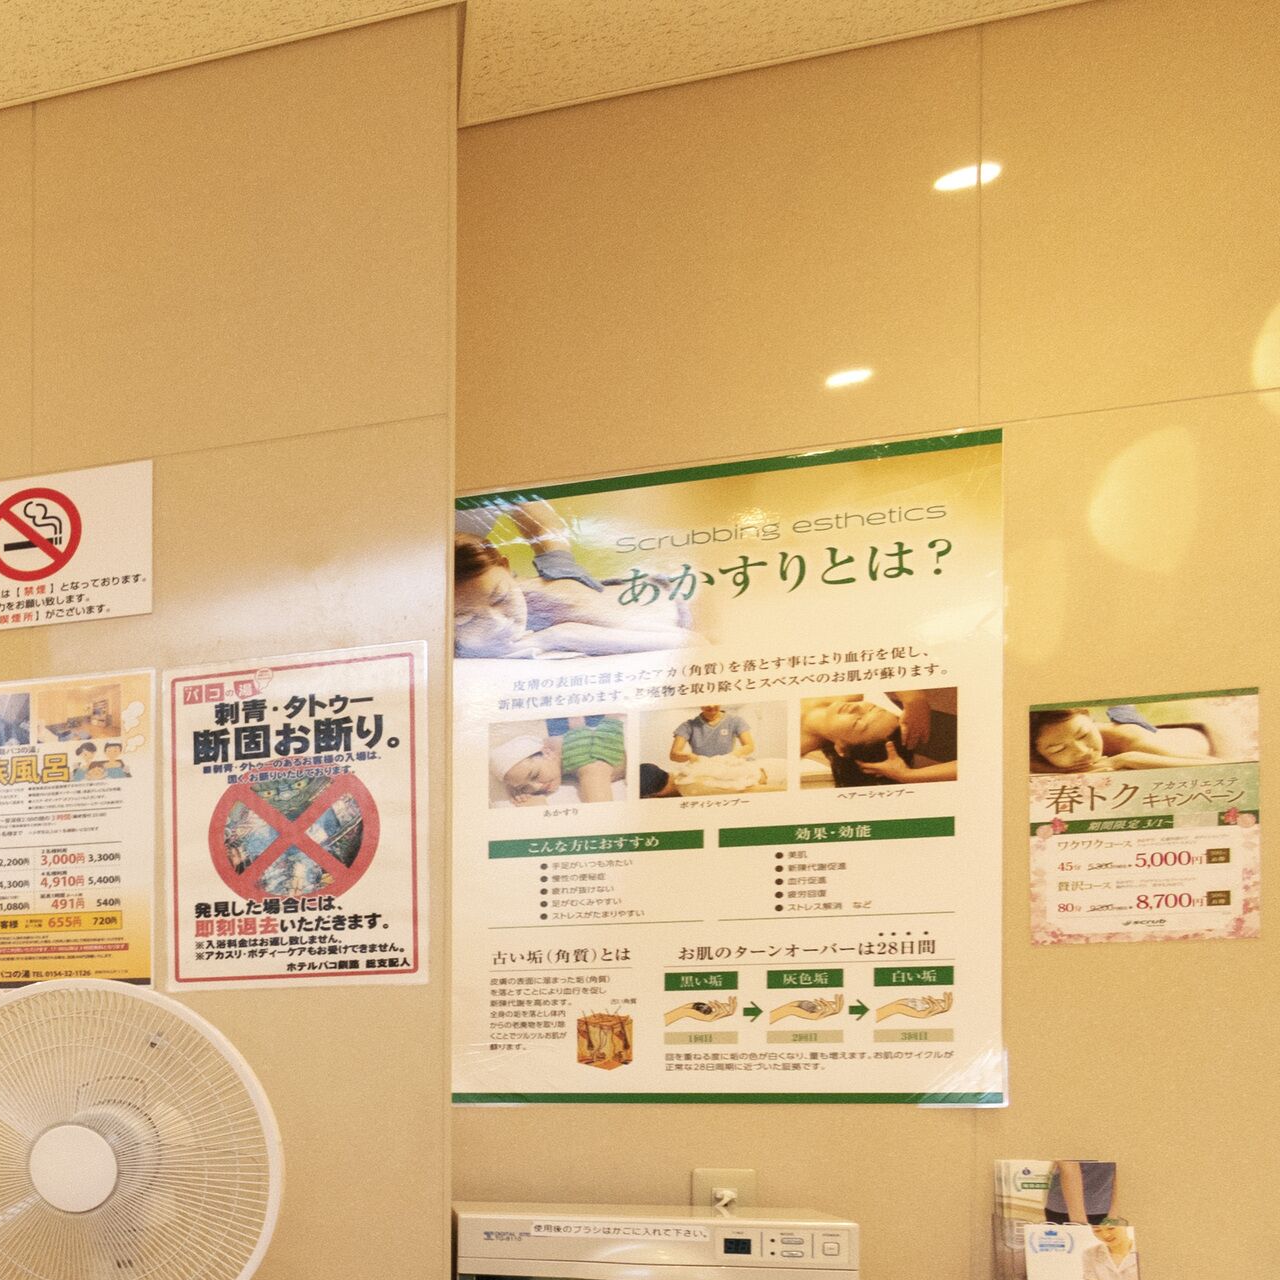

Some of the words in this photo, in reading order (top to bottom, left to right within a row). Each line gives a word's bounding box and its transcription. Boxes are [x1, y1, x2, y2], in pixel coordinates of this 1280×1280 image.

[616, 522, 780, 553] Scrubbing
[793, 505, 947, 533] esthetics
[618, 539, 952, 606] あかすりとは?
[214, 693, 374, 726] 刺青・タトゥー
[193, 714, 400, 765] 断固お断り。
[1153, 777, 1238, 791] アカスリエステ
[837, 788, 915, 800] ヘアーシャンプー
[1046, 783, 1140, 815] 春トク
[1143, 789, 1245, 809] キャンペーン
[528, 836, 659, 853] こんな方におすすめ
[795, 825, 871, 840] 効果・効能
[41, 853, 85, 866] 3,000円
[88, 853, 121, 863] 3,300円
[1135, 851, 1203, 868] 5,000円
[40, 875, 85, 888] 4,910円
[88, 875, 121, 885] 5,400円
[0, 902, 30, 911] 1,080円
[51, 897, 85, 910] 491円
[96, 898, 121, 907] 540円
[194, 896, 344, 918] 発見した場合には、
[1136, 893, 1204, 910] 8,700円
[48, 916, 82, 928] 655円
[92, 917, 117, 925] 720円
[194, 912, 391, 938] 即刻退去いただきます。
[678, 939, 936, 961] お肌のターンオーバーは28日間
[680, 973, 723, 988] 黒い垢
[782, 971, 829, 986] 灰色垢
[892, 969, 937, 983] 白い垢
[534, 1224, 708, 1239] 使用後のブラシはかごに入れて下さい。
